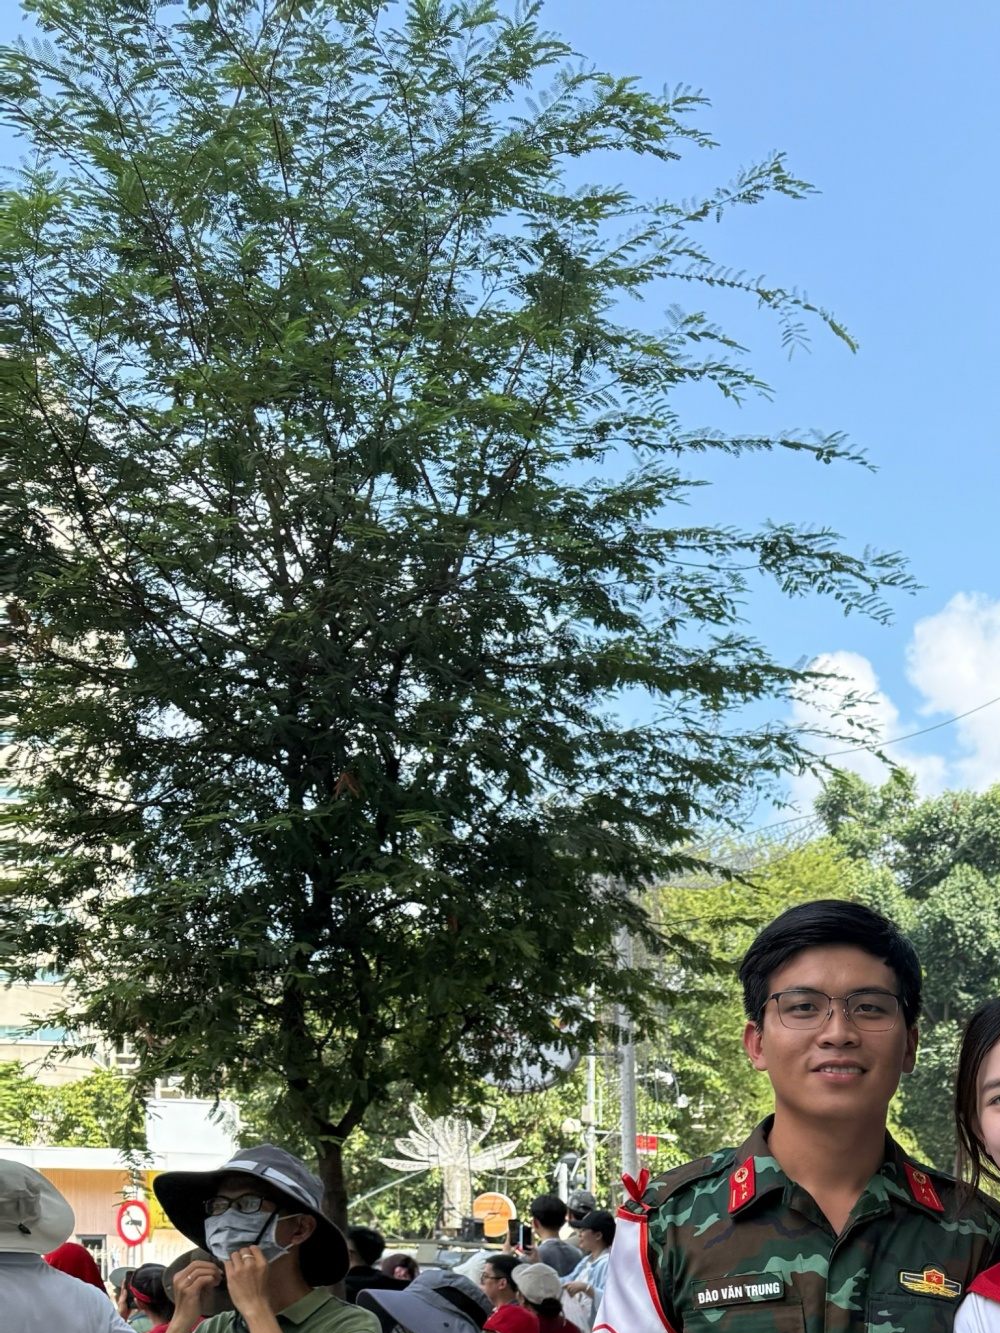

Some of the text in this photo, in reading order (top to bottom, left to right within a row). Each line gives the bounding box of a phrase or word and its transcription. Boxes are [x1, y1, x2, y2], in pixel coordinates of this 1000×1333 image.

[697, 1281, 781, 1304] ĐÀO VĂN TRUNG
